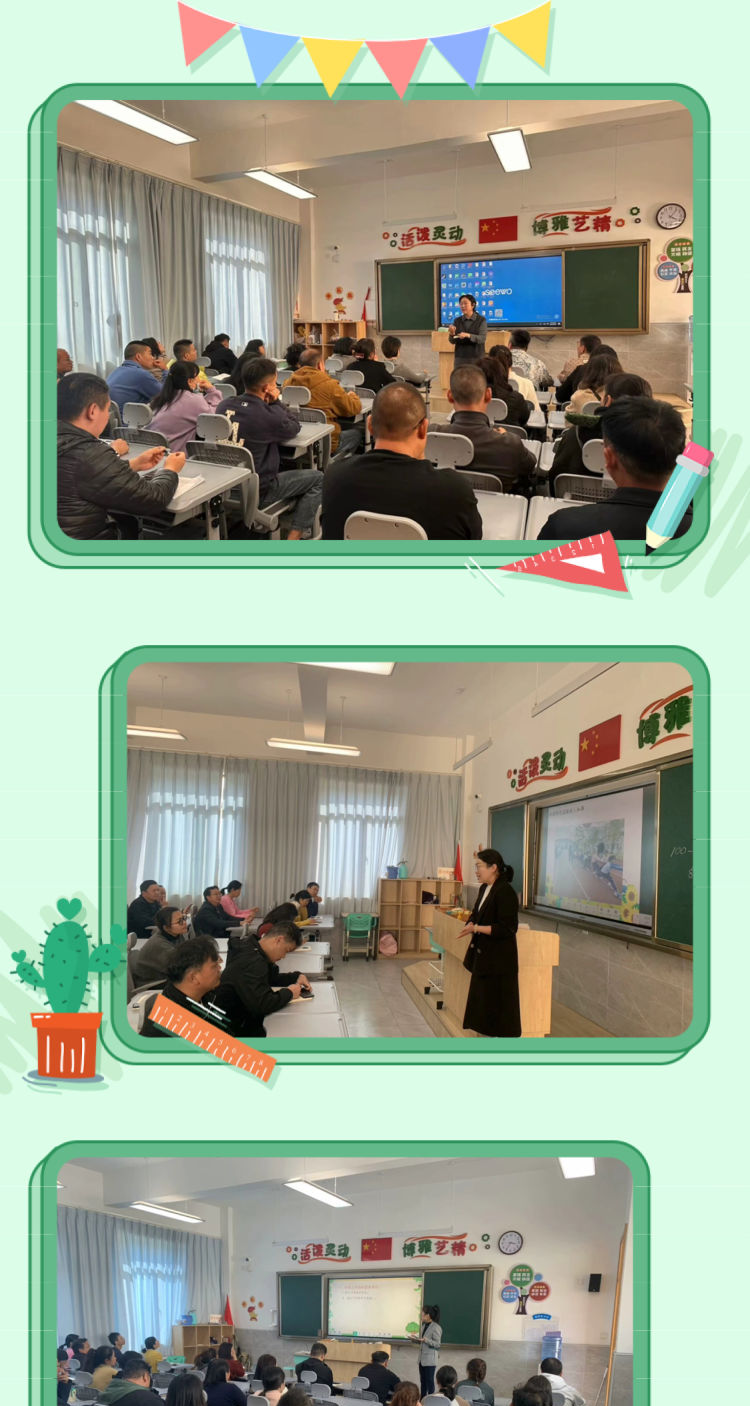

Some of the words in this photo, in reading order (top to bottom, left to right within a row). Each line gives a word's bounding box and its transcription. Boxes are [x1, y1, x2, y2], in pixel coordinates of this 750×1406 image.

[401, 225, 464, 247] 活泼灵动
[532, 214, 612, 236] 博雅艺精
[636, 695, 692, 749] 博雅
[517, 747, 566, 787] 活泼灵动
[300, 1243, 350, 1261] 活泼灵动
[402, 1239, 466, 1258] 博雅艺精
